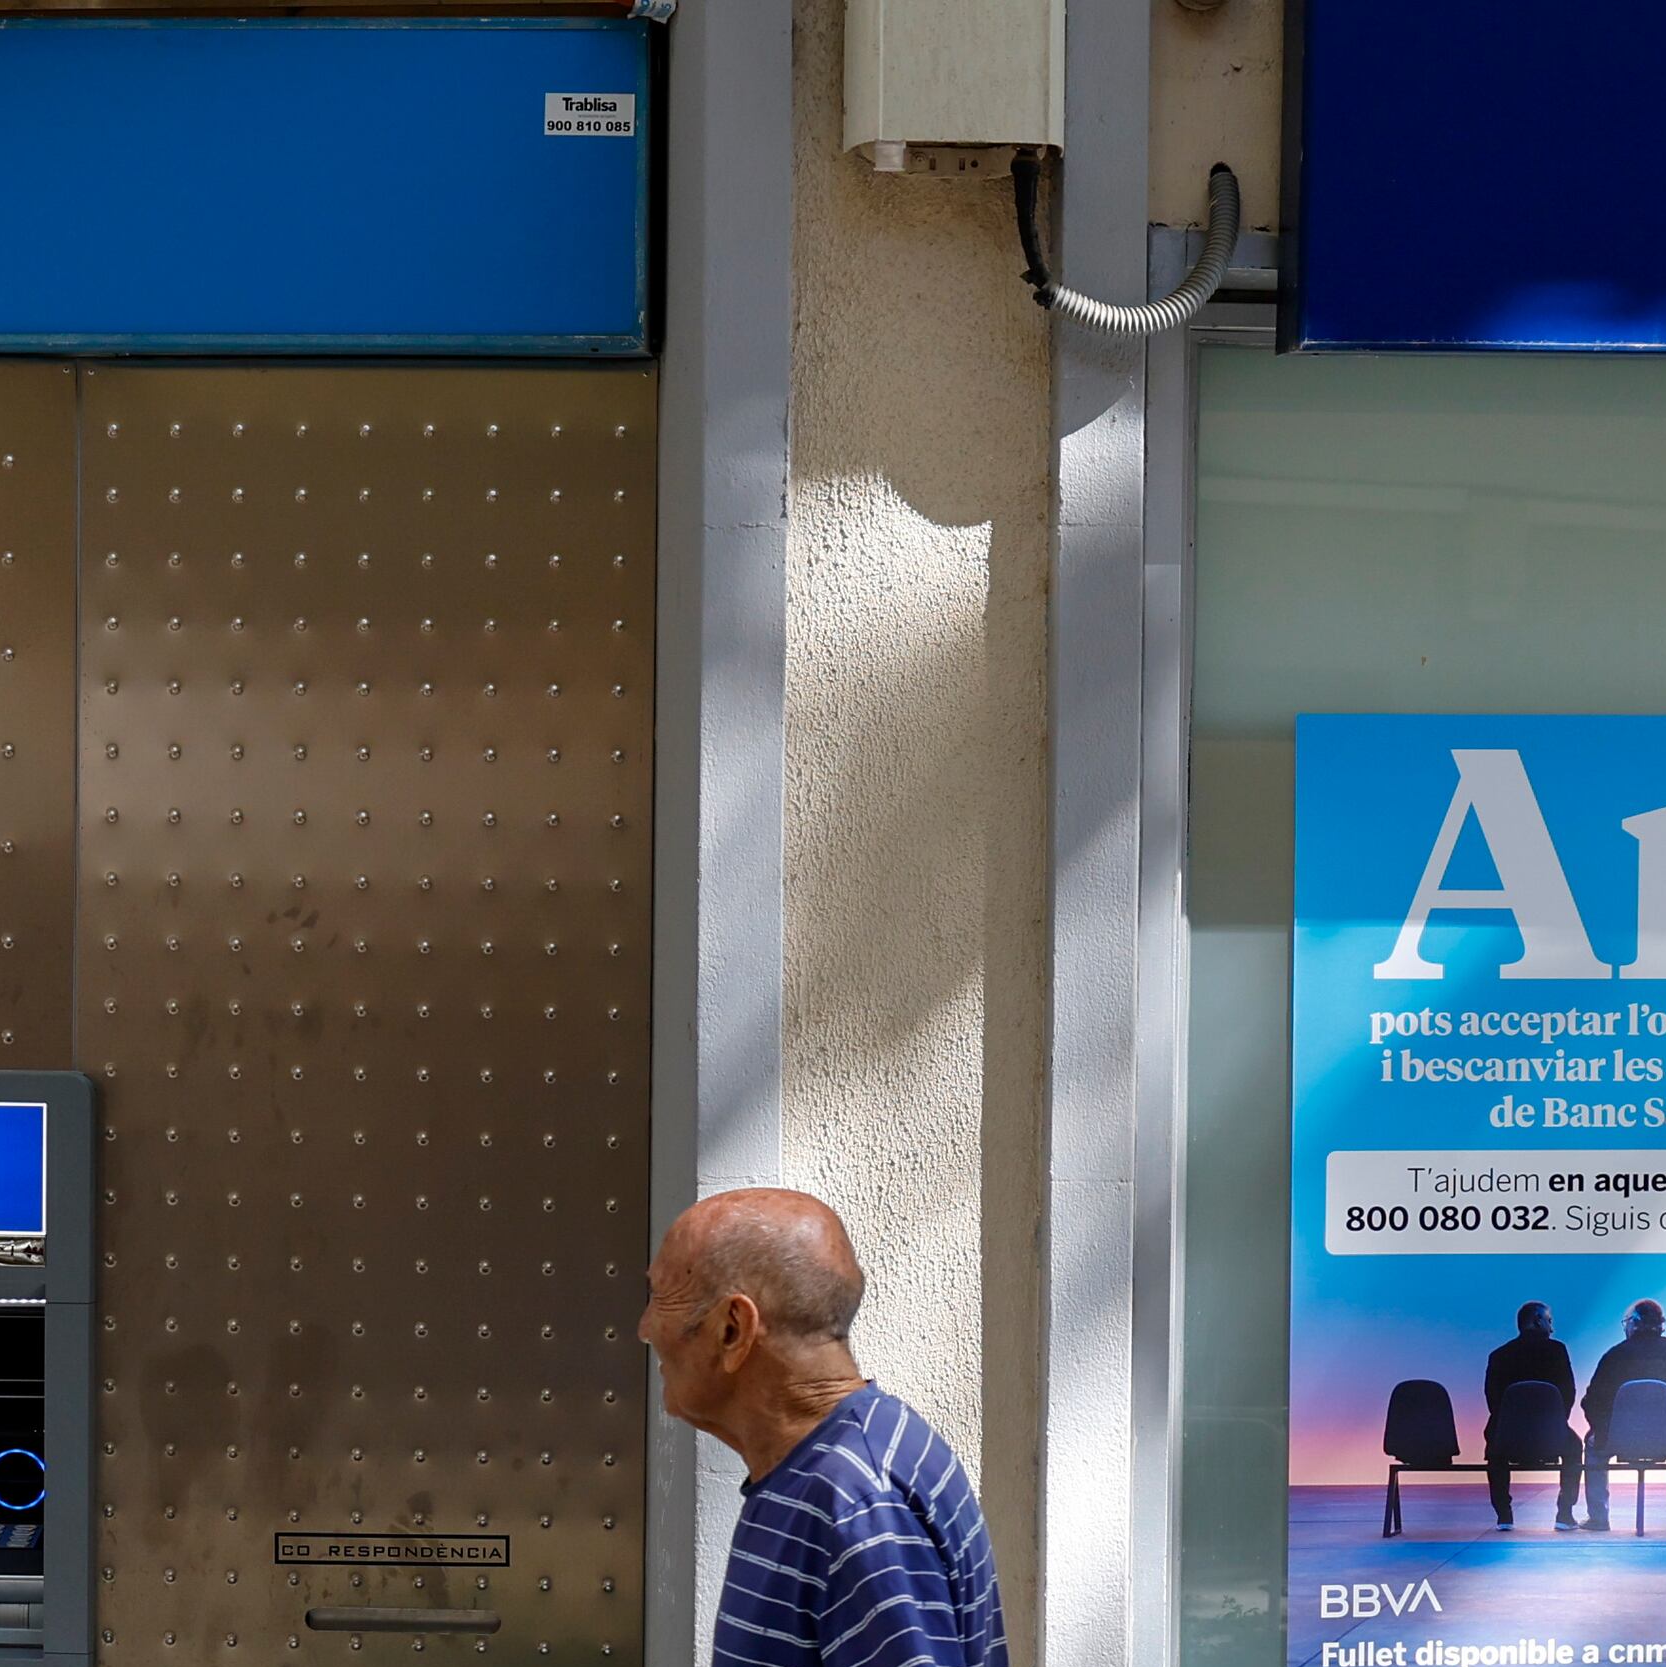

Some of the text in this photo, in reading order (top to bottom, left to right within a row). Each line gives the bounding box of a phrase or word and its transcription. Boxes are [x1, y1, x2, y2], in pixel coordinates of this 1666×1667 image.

[562, 97, 617, 112] Trablisa
[547, 120, 631, 132] 900 810 085
[1370, 1008, 1452, 1044] pots
[1460, 1008, 1621, 1044] acceptar
[1381, 1049, 1393, 1081] i
[1401, 1049, 1606, 1082] bescanviar
[1613, 1049, 1663, 1082] les
[1490, 1095, 1535, 1127] de
[1543, 1098, 1636, 1127] Banc
[1407, 1168, 1539, 1198] T'ajudem
[1549, 1174, 1583, 1192] en
[1347, 1206, 1408, 1231] 800
[1419, 1206, 1481, 1231] 080
[1491, 1206, 1555, 1230] 032.
[1566, 1206, 1650, 1236] Siguis
[1321, 1579, 1443, 1618] BBVA
[1323, 1642, 1407, 1667] Fullet
[1582, 1645, 1599, 1663] a
